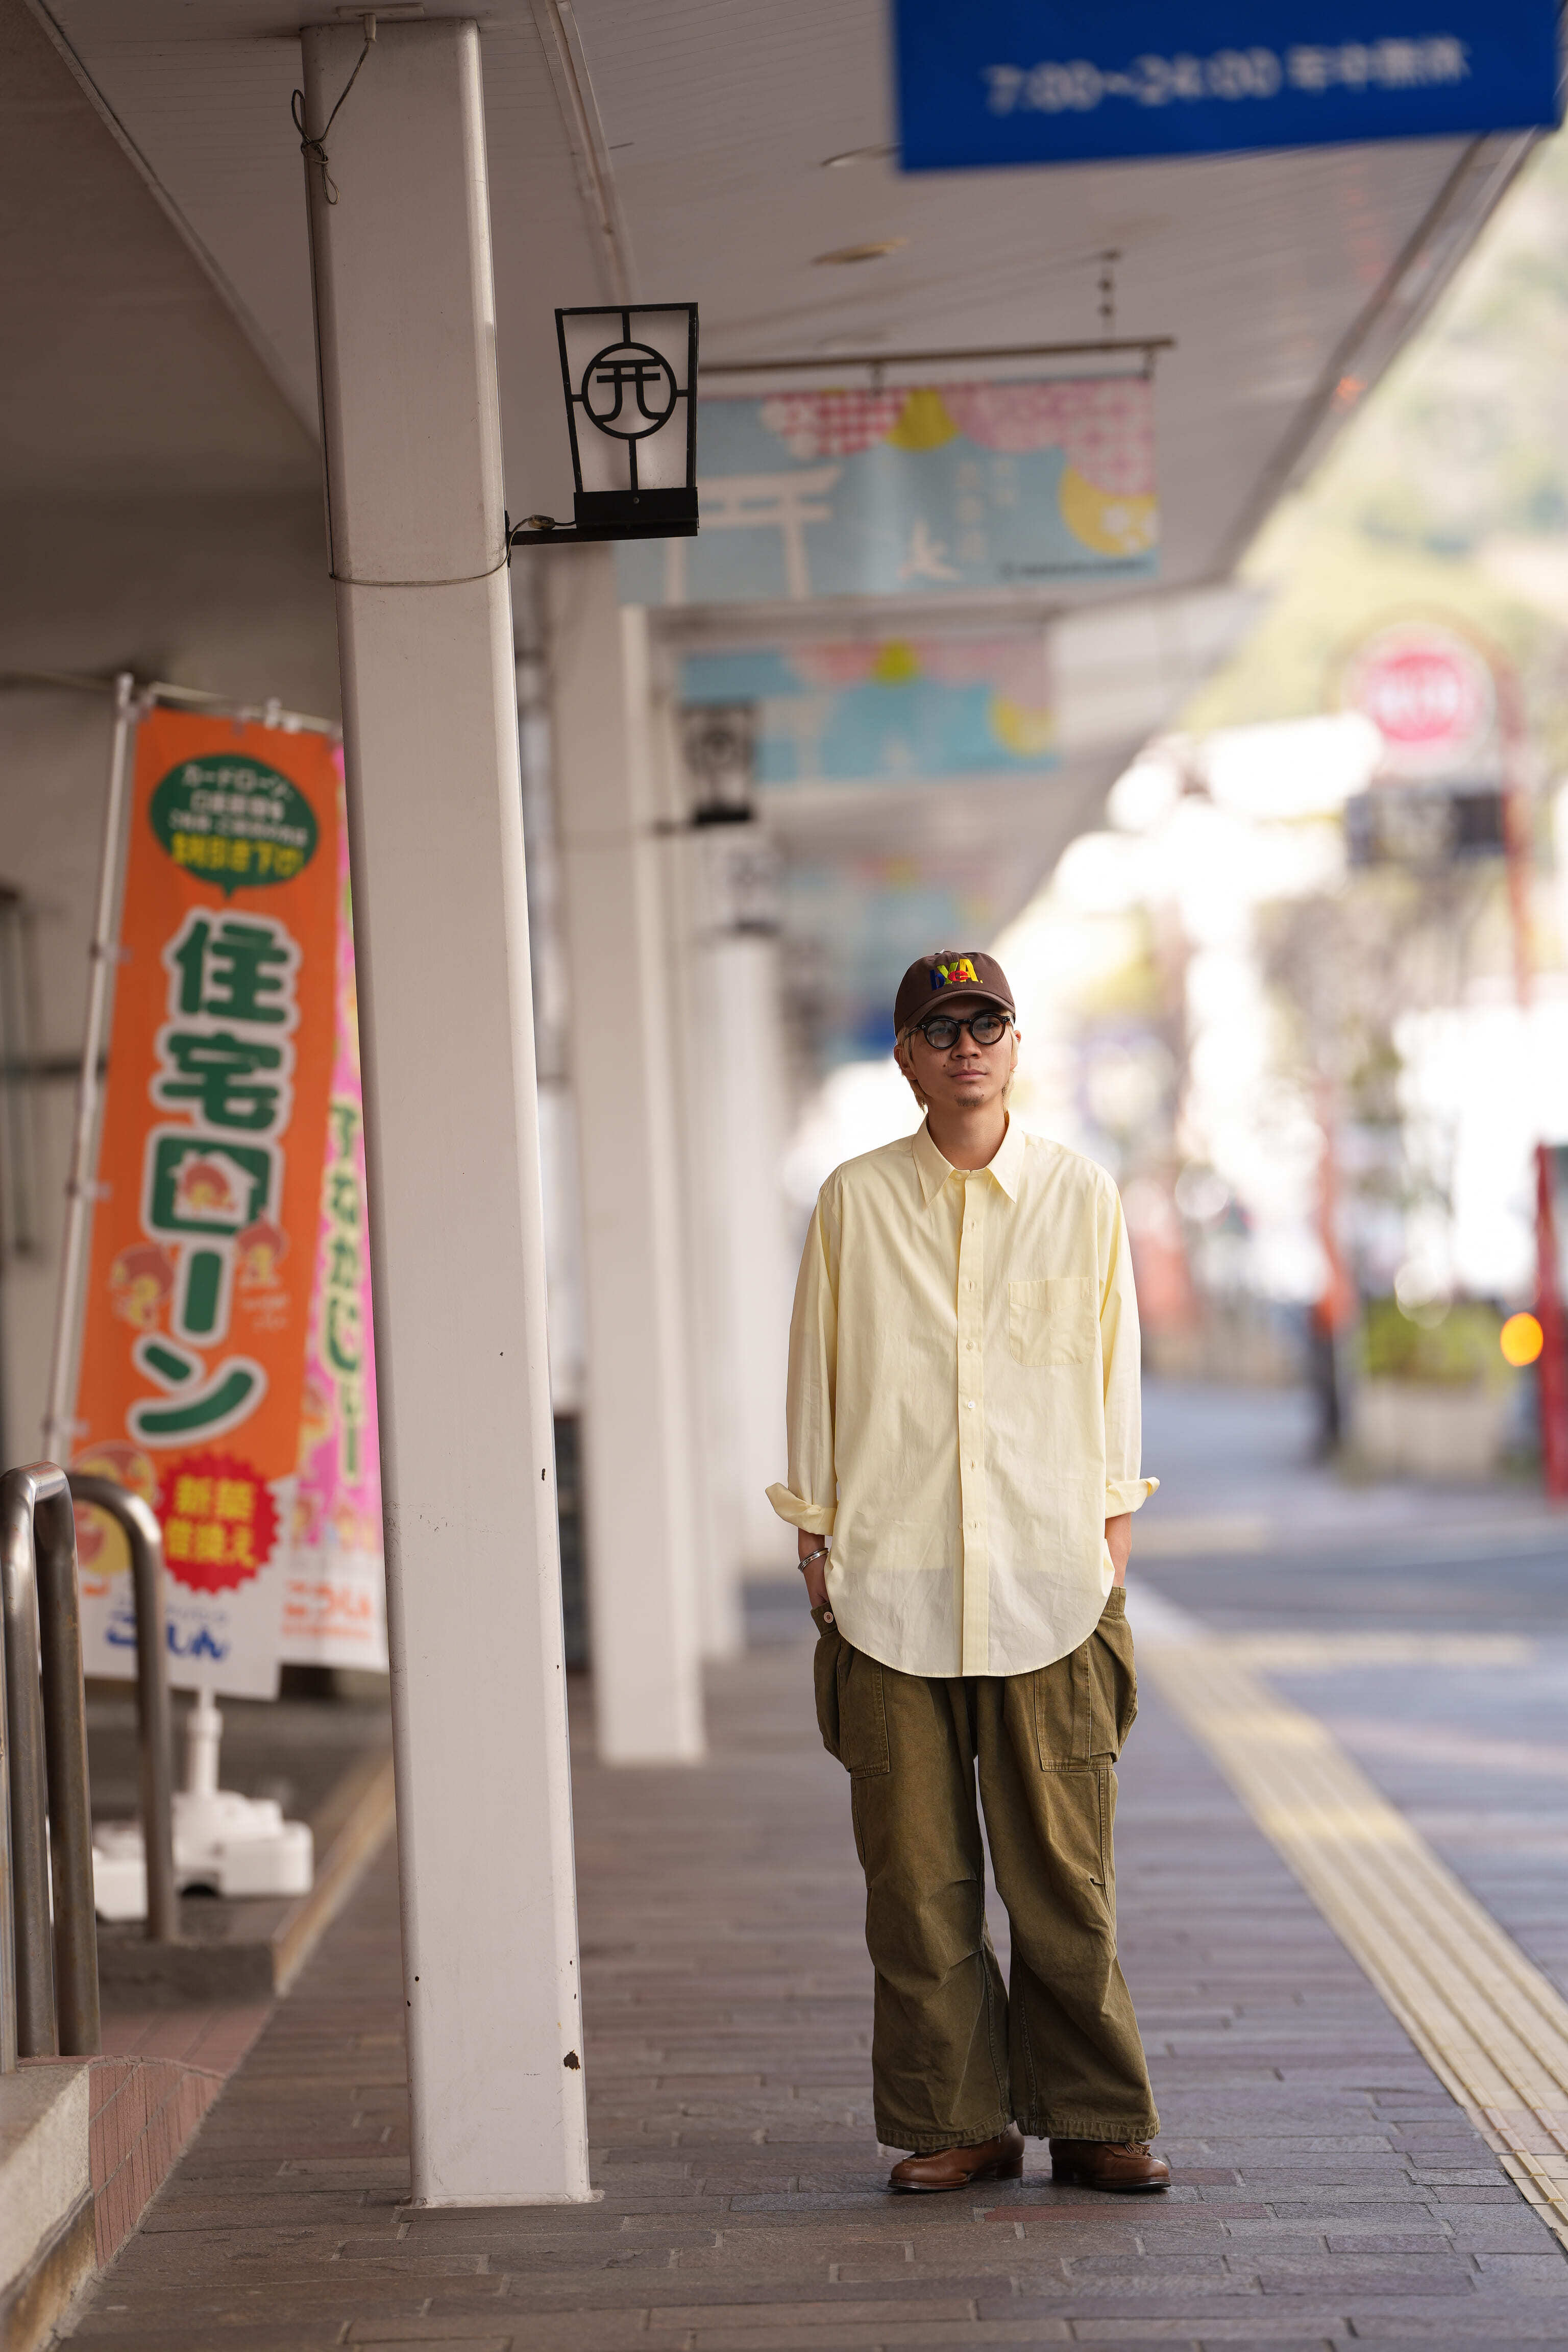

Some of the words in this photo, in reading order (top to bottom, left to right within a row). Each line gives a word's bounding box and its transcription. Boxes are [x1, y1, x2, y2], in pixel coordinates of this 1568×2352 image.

[132, 913, 295, 1438] 住宅ローン
